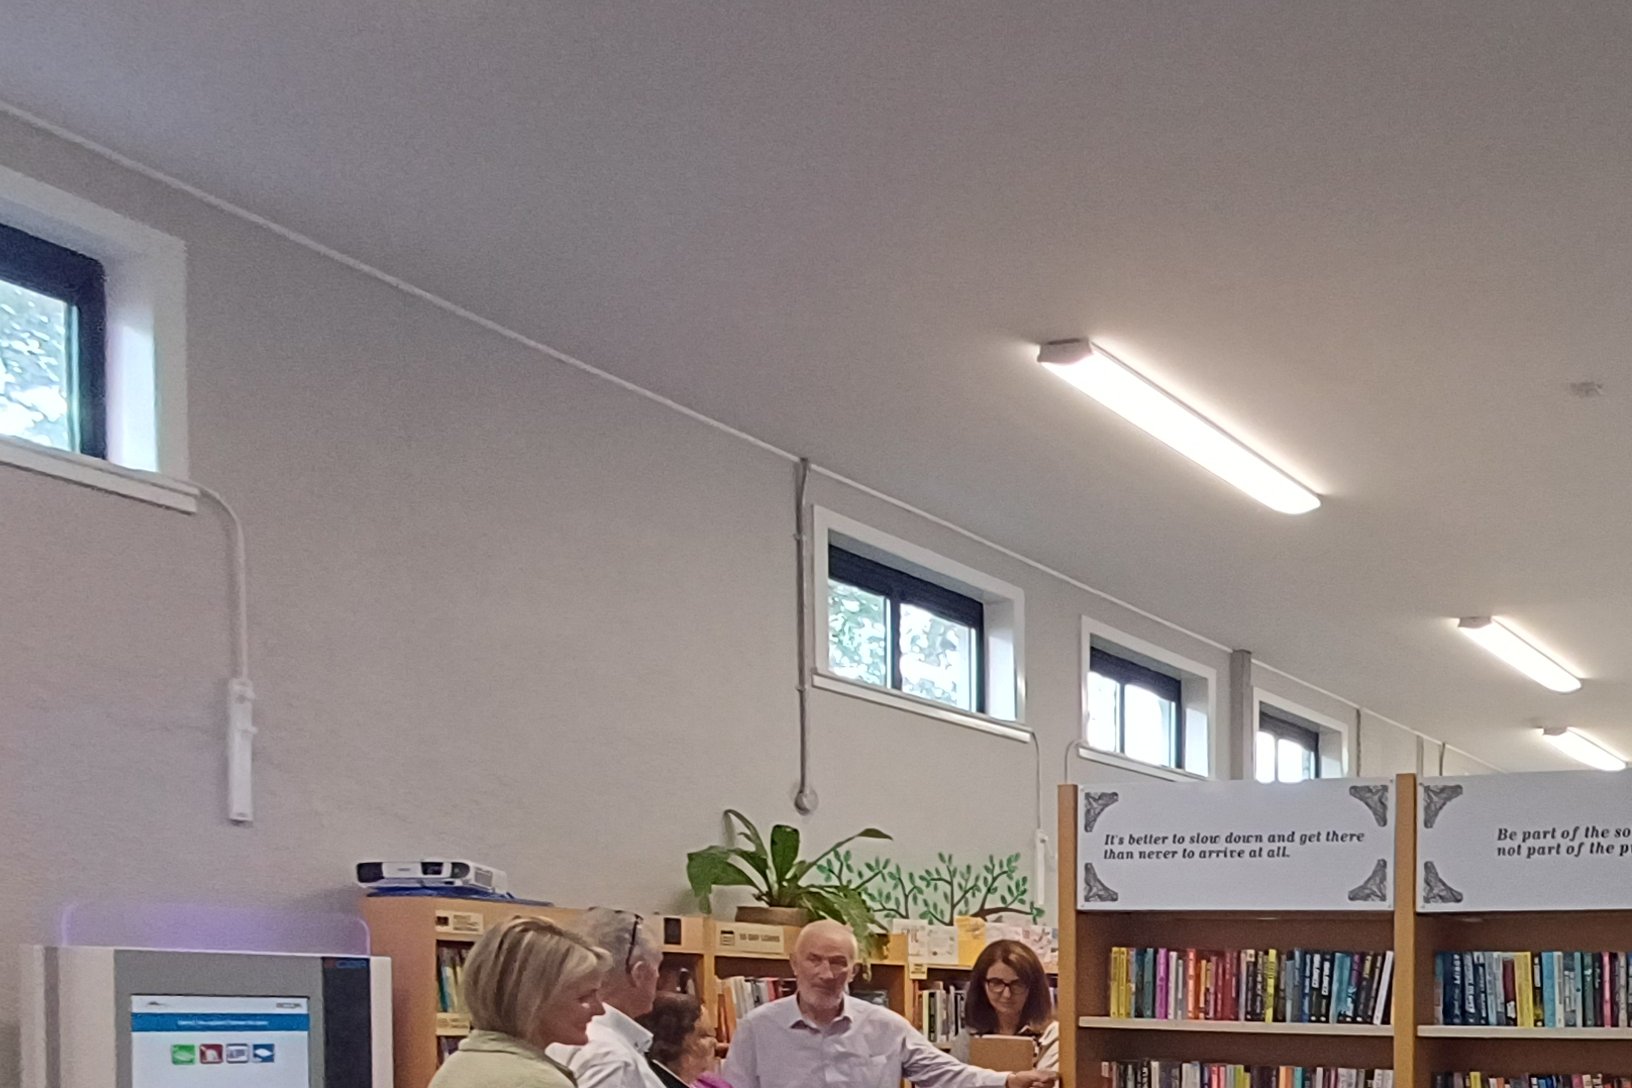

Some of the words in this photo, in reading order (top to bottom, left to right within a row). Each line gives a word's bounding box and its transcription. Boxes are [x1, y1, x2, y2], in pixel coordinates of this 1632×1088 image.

[1104, 834, 1125, 846] It's
[1128, 832, 1169, 846] better
[1172, 833, 1186, 845] to
[1189, 832, 1221, 845] slow
[1225, 832, 1264, 844] down
[1267, 831, 1295, 844] and
[1299, 831, 1322, 846] get
[1325, 831, 1365, 843] there
[1497, 828, 1518, 842] Be
[1522, 827, 1557, 843] part
[1560, 826, 1581, 842] of
[1584, 825, 1610, 839] the
[1103, 848, 1135, 860] than
[1138, 850, 1178, 860] never
[1182, 848, 1195, 859] to
[1199, 847, 1246, 859] arrive
[1249, 847, 1263, 859] at
[1267, 846, 1291, 859] all.
[1497, 843, 1522, 857] not
[1526, 843, 1562, 859] part
[1565, 842, 1585, 858] of
[1589, 841, 1615, 855] the
